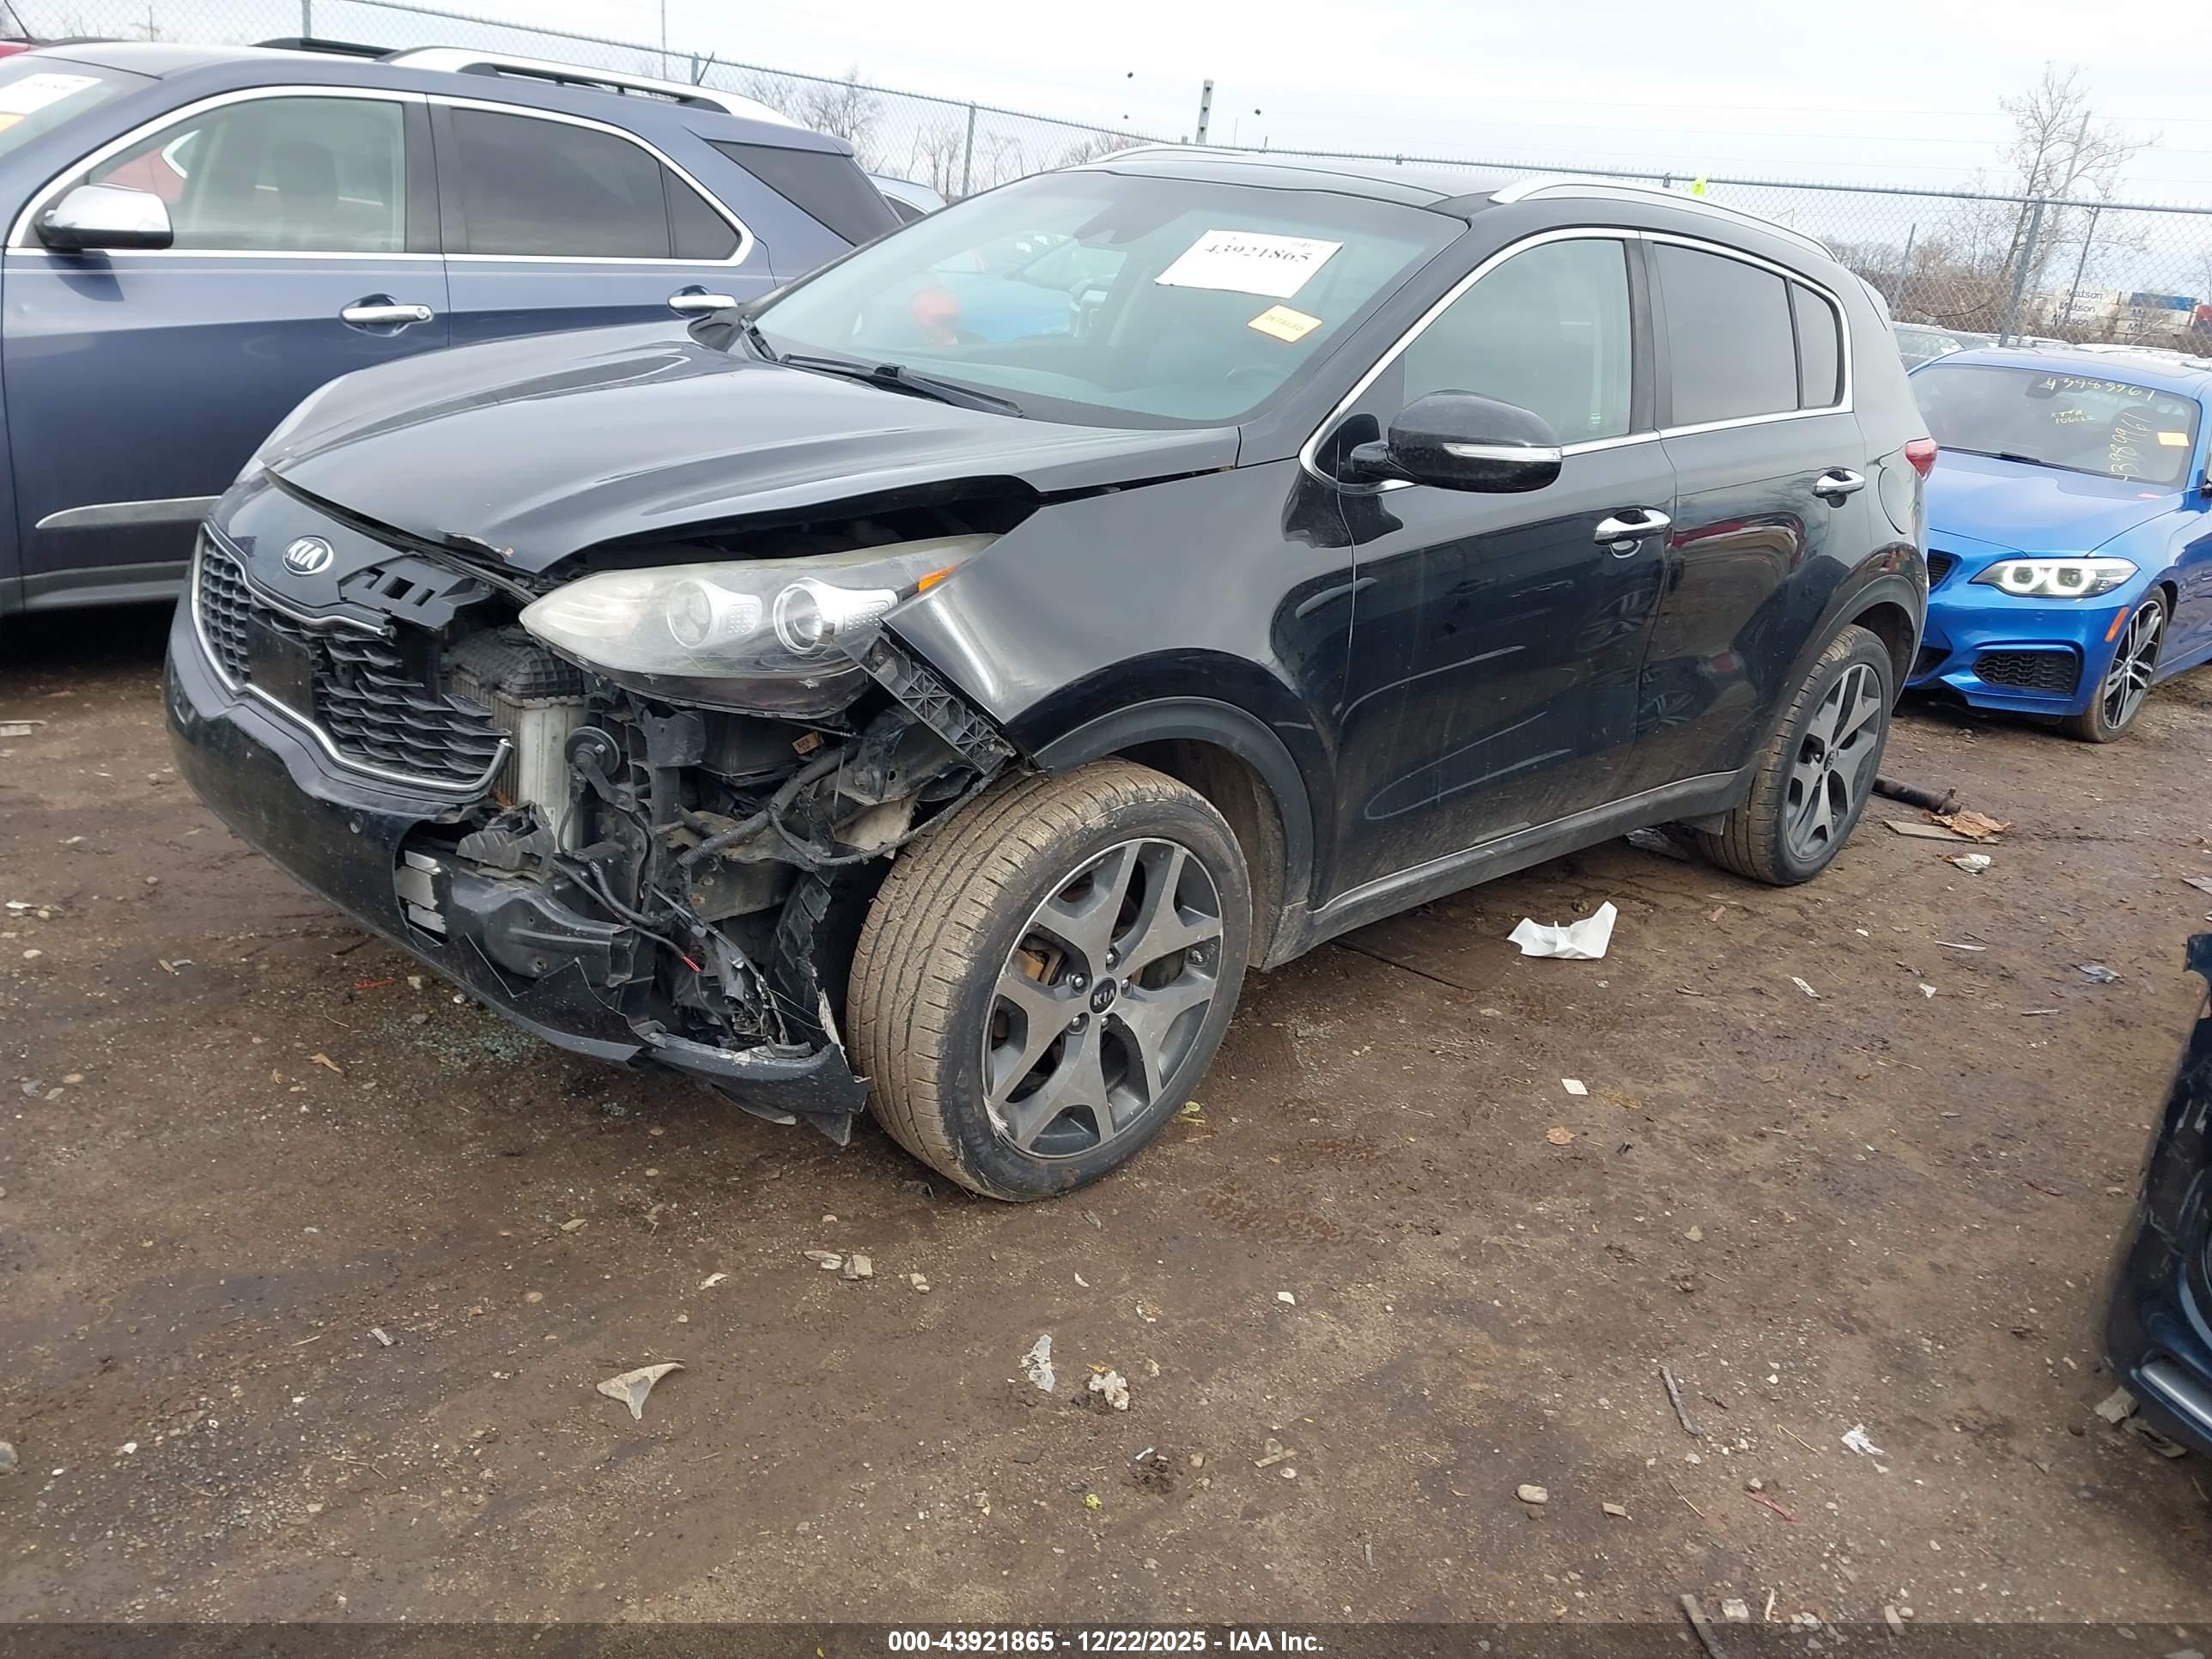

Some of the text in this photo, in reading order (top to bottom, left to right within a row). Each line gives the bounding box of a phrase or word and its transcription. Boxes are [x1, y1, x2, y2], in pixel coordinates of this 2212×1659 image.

[1205, 245, 1313, 262] 43921865
[285, 539, 325, 570] KIA
[1093, 988, 1115, 1006] KIA
